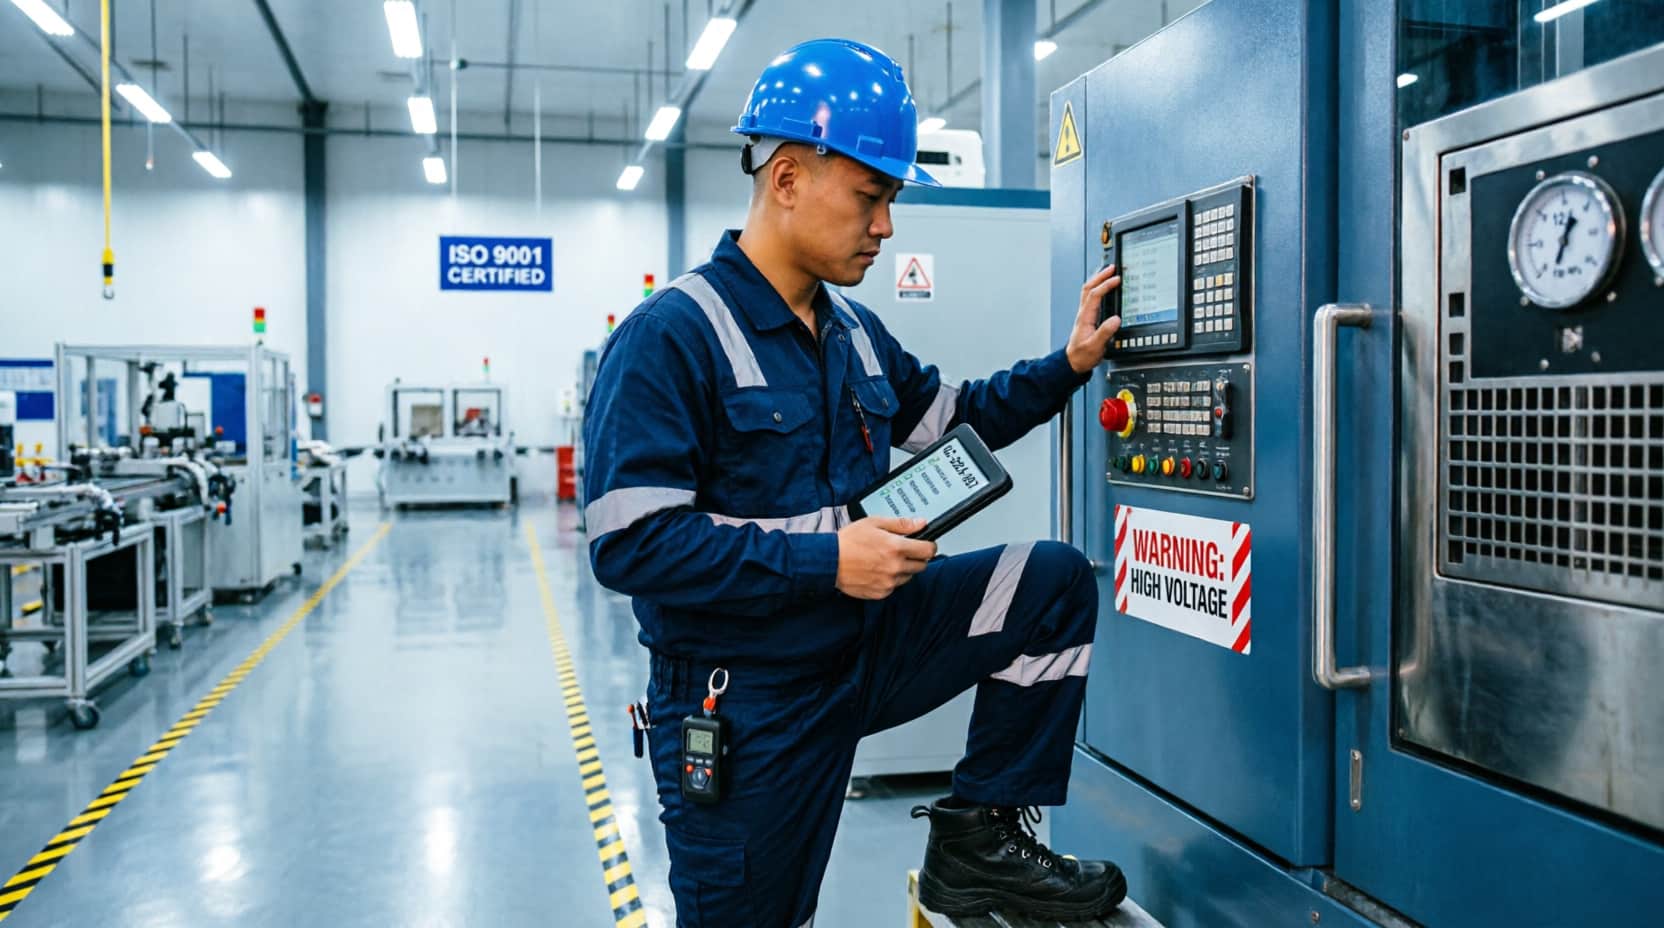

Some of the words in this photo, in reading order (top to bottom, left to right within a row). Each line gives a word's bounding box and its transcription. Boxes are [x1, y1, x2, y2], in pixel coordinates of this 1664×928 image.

[449, 244, 489, 265] ISO
[492, 245, 543, 265] 9001
[447, 266, 546, 285] CERTIFIED
[1133, 528, 1225, 582] WARNING:
[1131, 568, 1161, 601] HIGH
[1165, 575, 1228, 619] VOLTAGE
